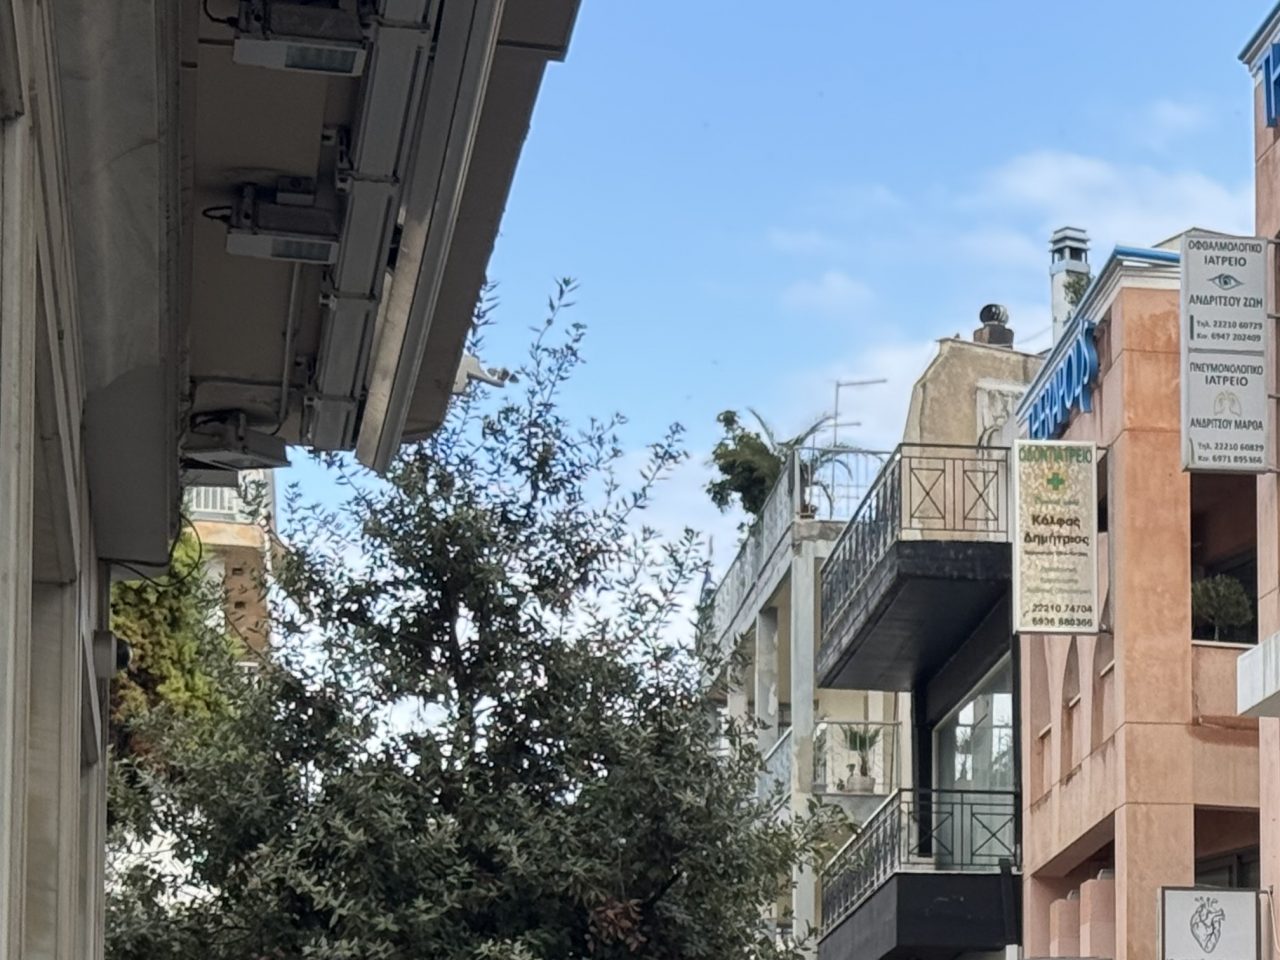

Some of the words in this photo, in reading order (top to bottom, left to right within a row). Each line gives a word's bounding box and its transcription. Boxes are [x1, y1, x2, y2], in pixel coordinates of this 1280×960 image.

[1204, 255, 1247, 267] ΙΑΤΡΕΙΟ
[1189, 294, 1241, 308] ΑΝΔΡΙΤΣΟΥ
[1243, 297, 1263, 308] ΖΩΗ
[1205, 375, 1248, 386] ΙΑΤΡΕΙΟ
[1190, 417, 1232, 430] ΑΝΔΡΙΤΣΟΥ
[1032, 514, 1080, 529] Κάλφας
[1024, 531, 1089, 547] Δημήτριος
